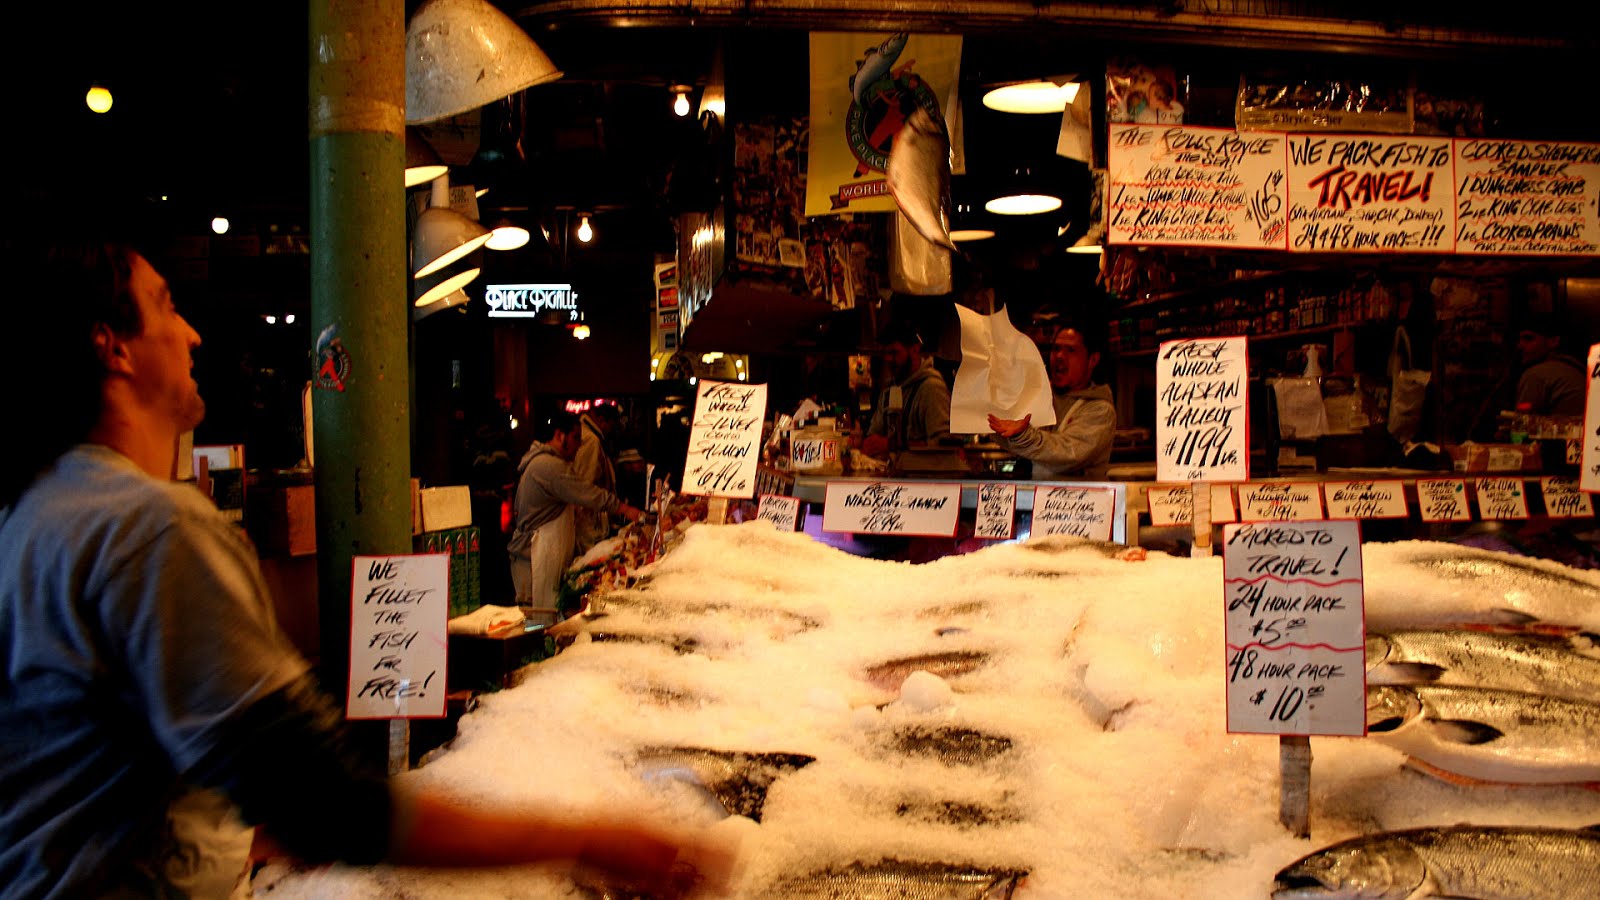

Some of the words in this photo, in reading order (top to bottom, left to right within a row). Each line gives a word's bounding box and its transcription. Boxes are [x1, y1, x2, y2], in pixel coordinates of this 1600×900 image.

[1113, 126, 1152, 147] THE
[1162, 127, 1216, 151] ROLLS
[1216, 132, 1279, 164] ROYCE
[1289, 138, 1326, 166] WE
[1327, 140, 1382, 167] PACK
[1380, 142, 1430, 167] FISH
[1428, 144, 1449, 167] TO
[1461, 141, 1529, 161] COOKED
[1489, 160, 1569, 179] SAMPLER
[842, 182, 888, 198] WORLD
[1308, 165, 1435, 212] TRAVEL!
[1469, 176, 1545, 196] DUNGENESS
[1134, 206, 1170, 227] KING
[1459, 200, 1473, 220] 2
[1487, 198, 1521, 217] KING
[1554, 199, 1584, 215] LEGS
[1295, 223, 1319, 249] 24
[1330, 223, 1354, 248] 48
[1352, 231, 1381, 248] HOUR
[1482, 221, 1532, 241] COOKED
[1531, 222, 1585, 240] PRAWNS
[1163, 341, 1229, 360] FRESH
[1172, 360, 1229, 377] WHOLE
[702, 382, 755, 404] FRESH
[1161, 376, 1240, 406] ALASKAN
[708, 401, 752, 413] WHOLE
[1165, 405, 1242, 429] HALIBUT
[694, 414, 759, 431] SILVER
[688, 440, 751, 460] SALMON
[1333, 490, 1358, 501] BLUE
[1228, 525, 1305, 549] PACKED
[1305, 530, 1333, 546] TO
[368, 558, 404, 581] WE
[365, 581, 437, 605] FILLET
[1229, 581, 1267, 617] 24
[1263, 596, 1302, 612] HOUR
[1303, 595, 1346, 613] PACK
[374, 610, 409, 626] THE
[369, 631, 419, 650] FISH
[373, 655, 402, 673] FOR
[1229, 648, 1258, 683] 48
[1257, 662, 1297, 681] HOUR
[1297, 664, 1345, 681] PACK
[358, 670, 436, 700] FREE!
